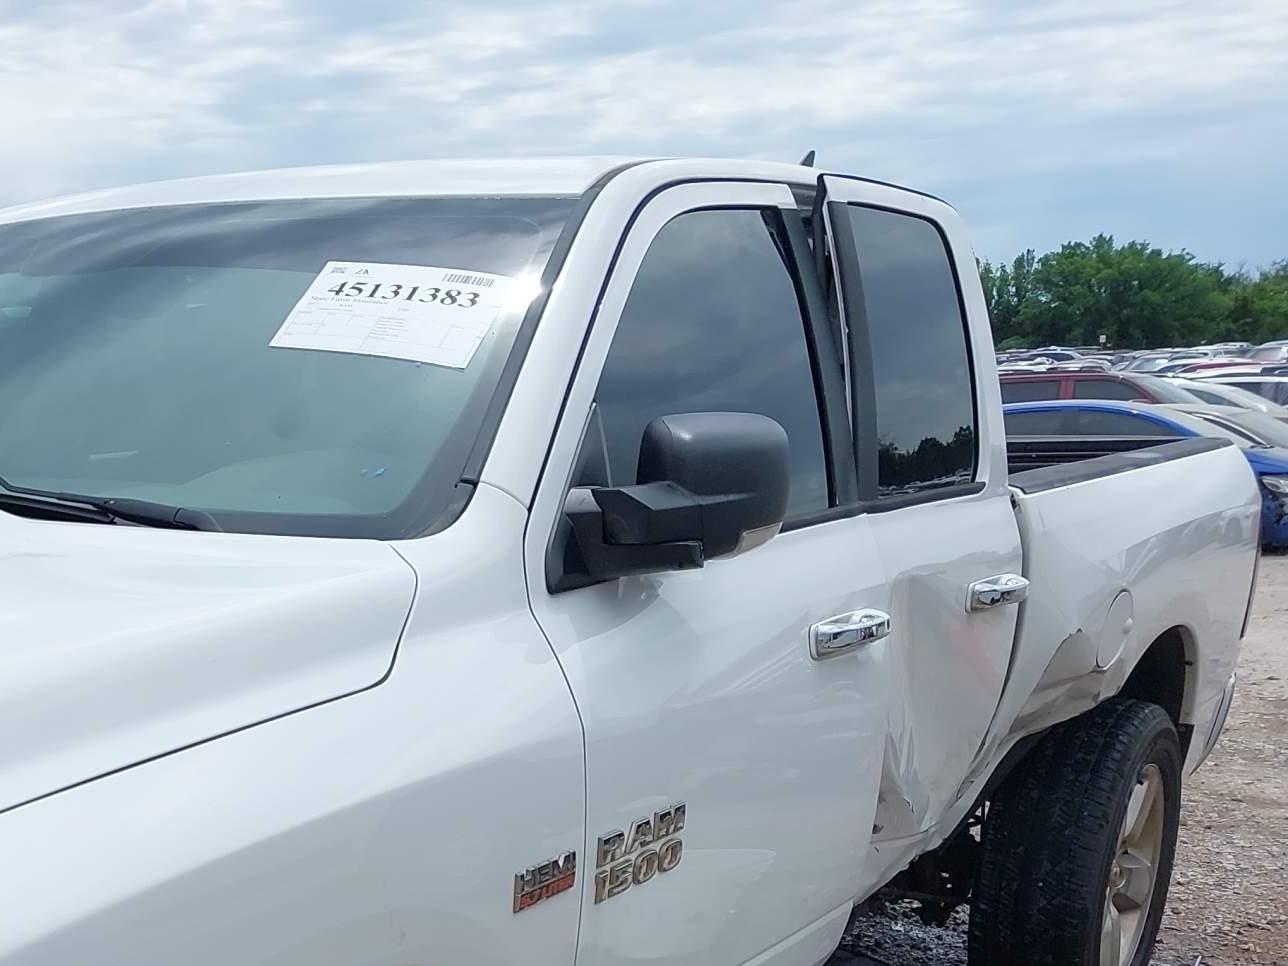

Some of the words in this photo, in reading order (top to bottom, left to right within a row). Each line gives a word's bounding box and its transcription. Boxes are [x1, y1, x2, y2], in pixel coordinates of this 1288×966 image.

[328, 281, 480, 308] 45131383
[596, 801, 687, 869] RAM
[514, 849, 577, 900] HEMI
[594, 837, 684, 905] 1500
